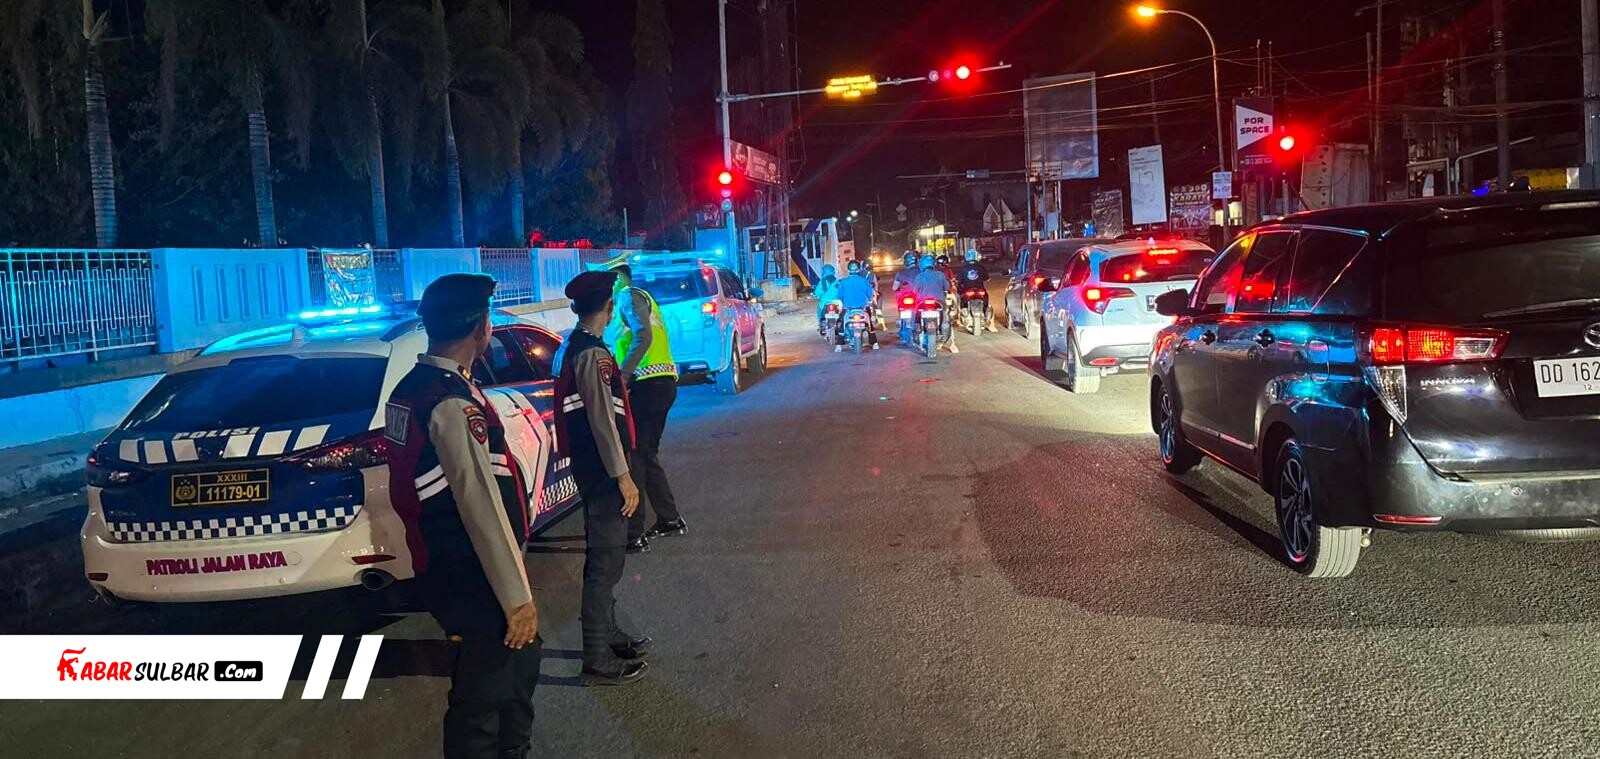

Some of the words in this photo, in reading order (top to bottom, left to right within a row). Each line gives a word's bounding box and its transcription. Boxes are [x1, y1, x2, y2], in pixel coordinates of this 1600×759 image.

[1240, 126, 1270, 134] SPACE
[1541, 364, 1563, 383] DD
[173, 426, 260, 440] POLISI
[217, 473, 247, 482] XXXIII
[207, 485, 260, 501] 11179-01
[146, 558, 199, 575] PATROLI
[201, 555, 246, 573] JALAN
[248, 551, 287, 569] RAYA
